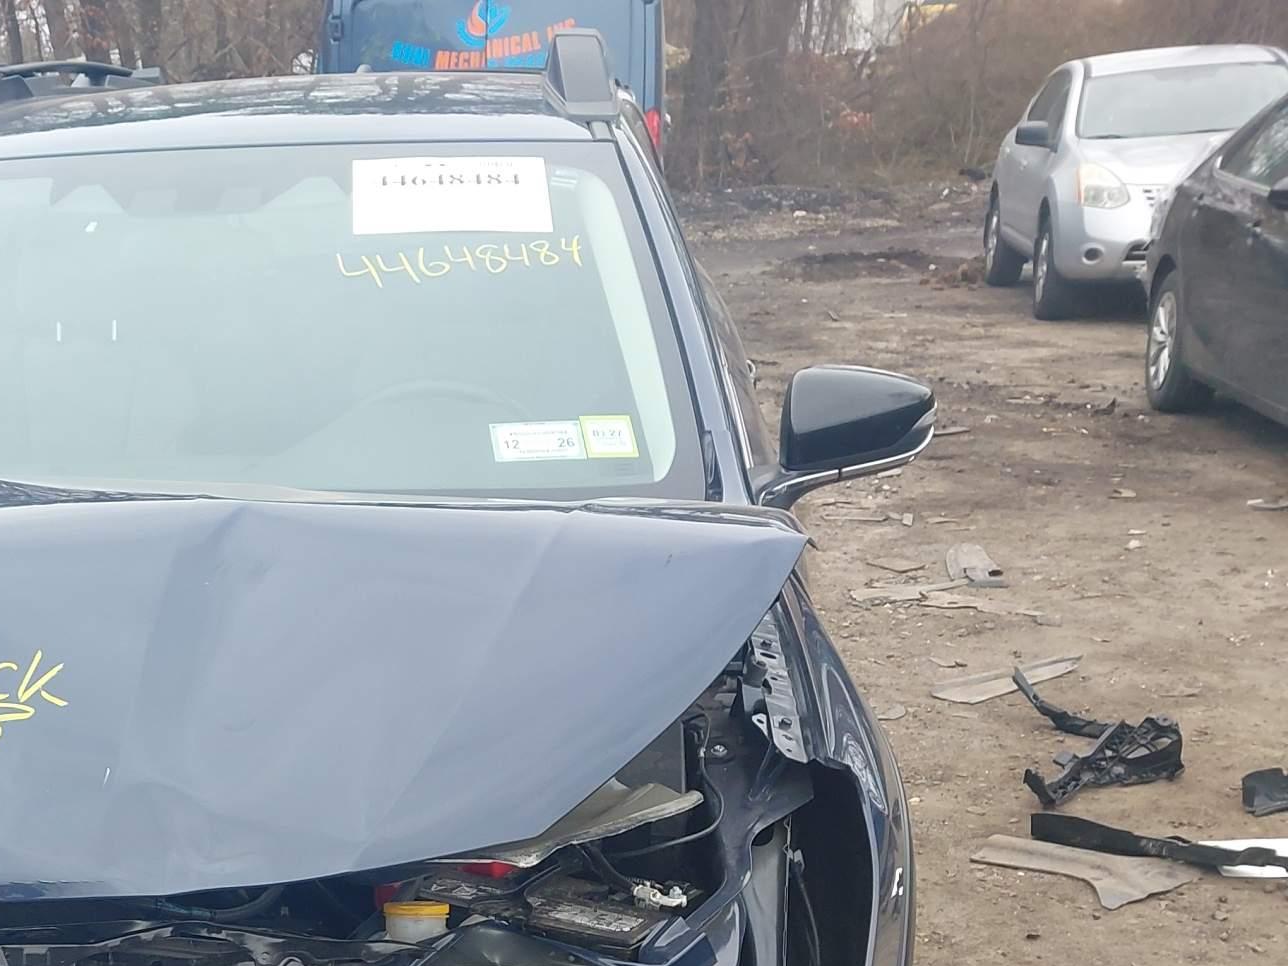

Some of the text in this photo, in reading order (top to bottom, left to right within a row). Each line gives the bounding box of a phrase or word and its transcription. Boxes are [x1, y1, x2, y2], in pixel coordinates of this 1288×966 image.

[336, 234, 582, 289] 44648484
[504, 437, 576, 450] 12 26
